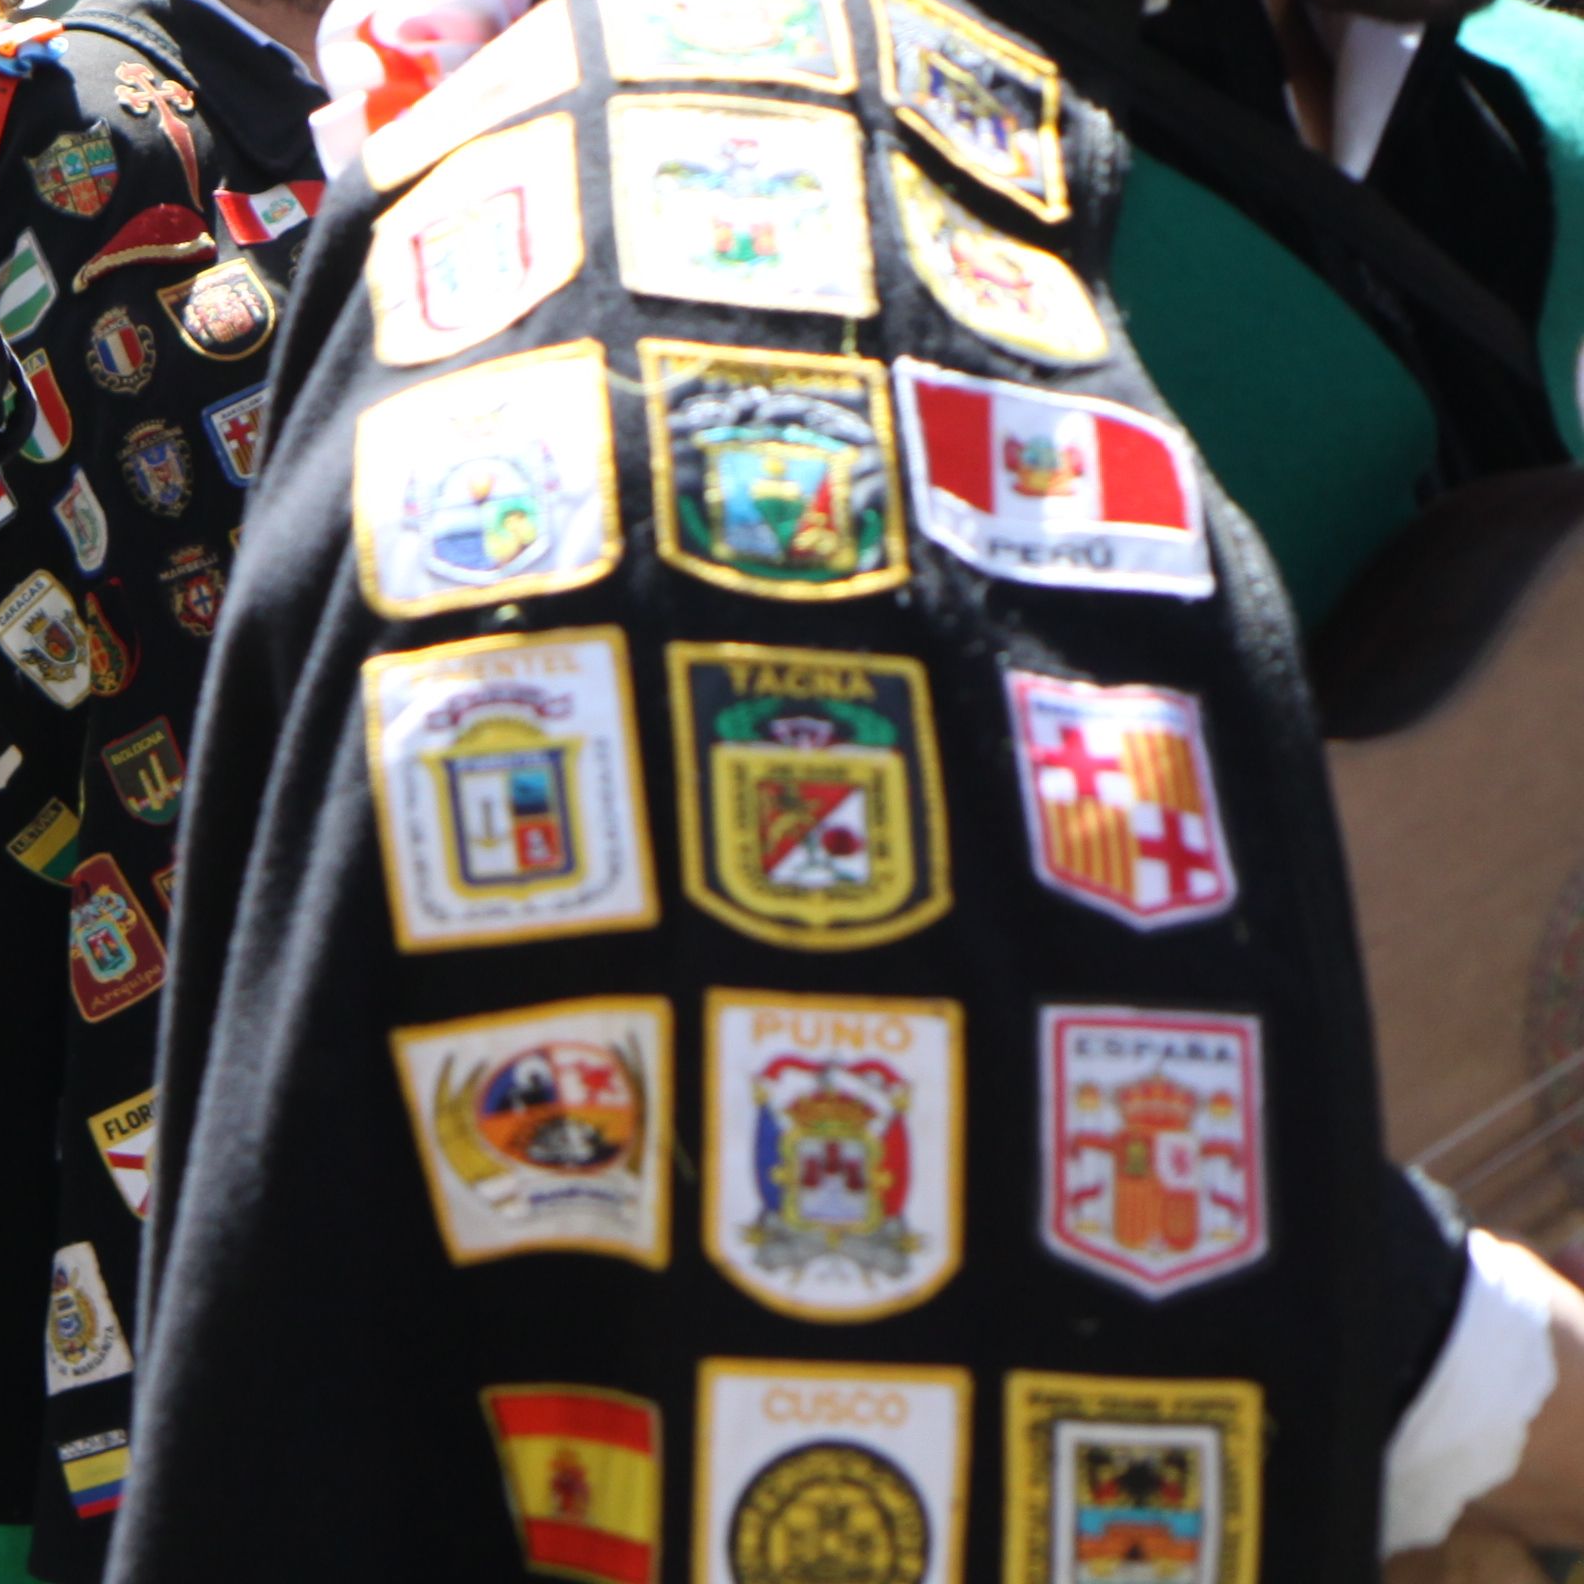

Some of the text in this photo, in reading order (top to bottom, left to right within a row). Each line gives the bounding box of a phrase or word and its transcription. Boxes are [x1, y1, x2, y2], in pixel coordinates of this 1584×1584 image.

[750, 1011, 912, 1053] PUNO
[1075, 1030, 1234, 1064] ESPAÑA
[760, 1386, 911, 1428] CUSCO
